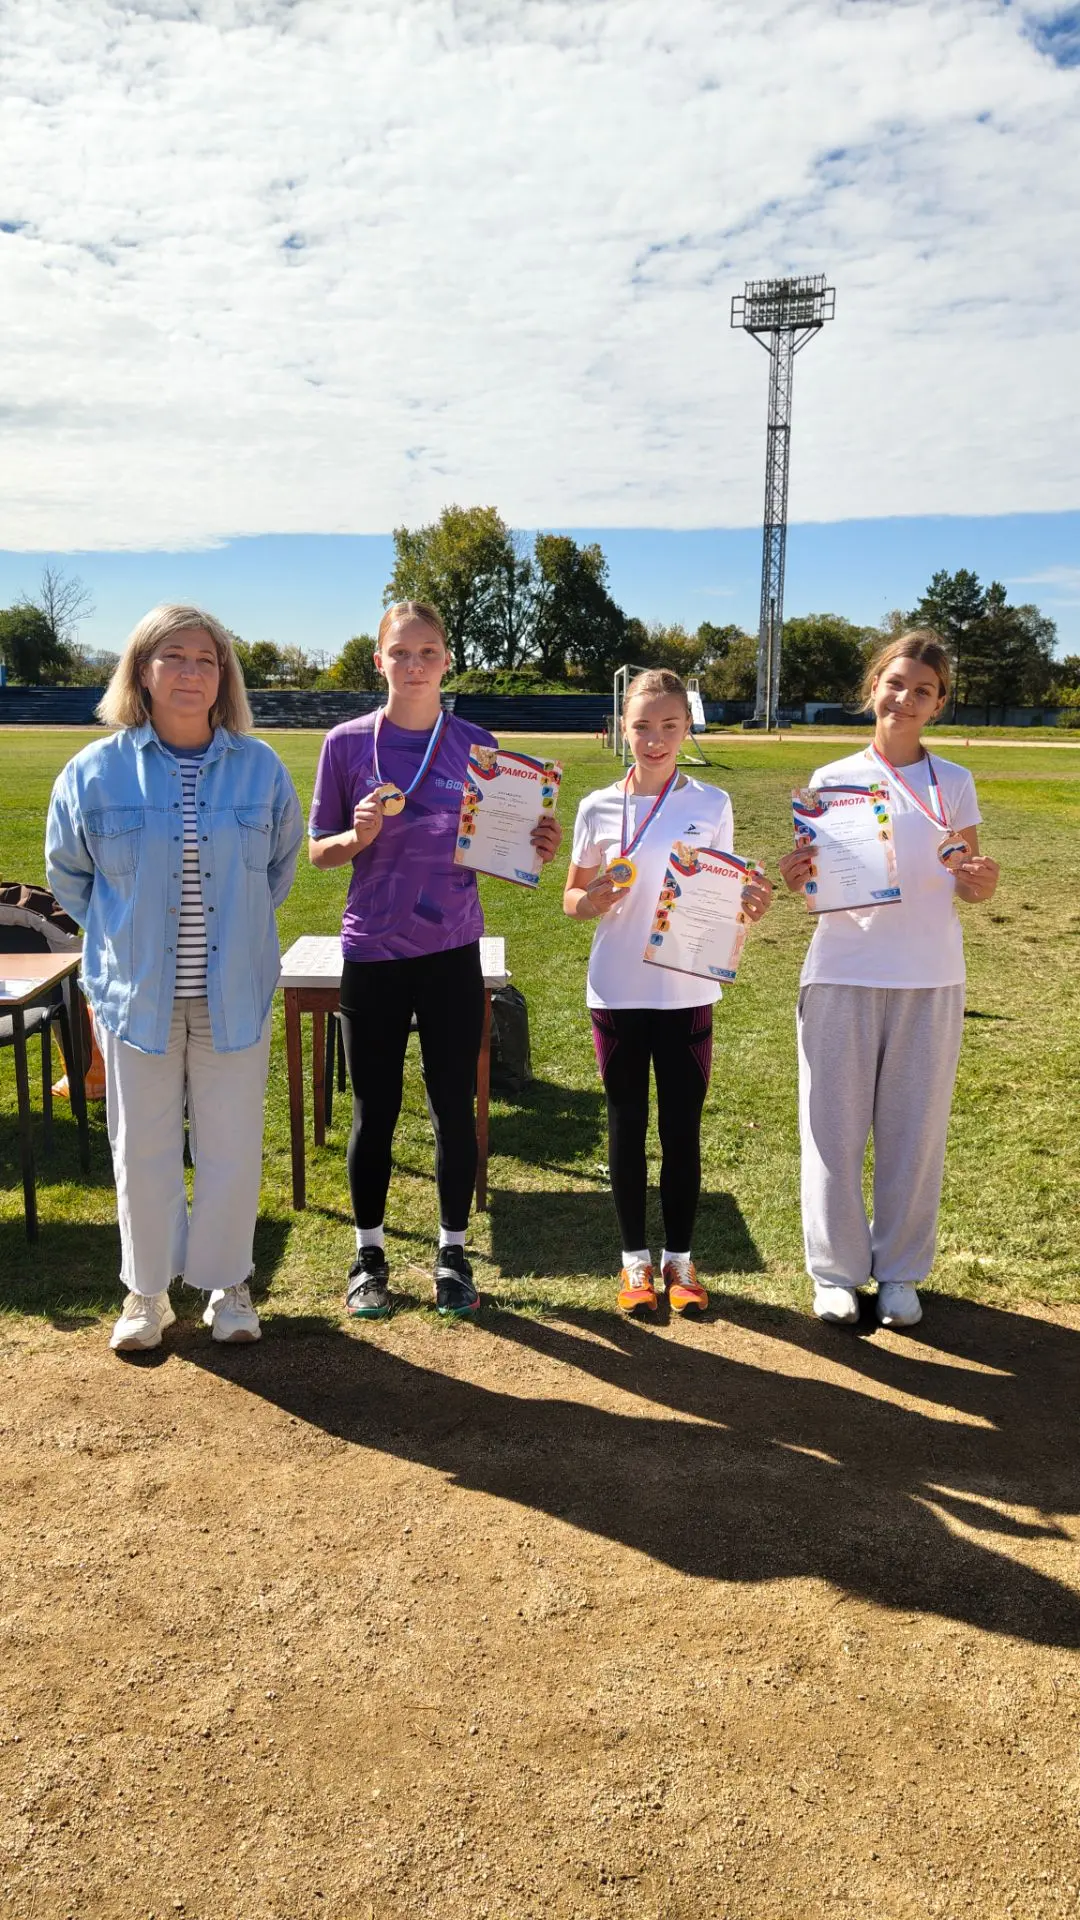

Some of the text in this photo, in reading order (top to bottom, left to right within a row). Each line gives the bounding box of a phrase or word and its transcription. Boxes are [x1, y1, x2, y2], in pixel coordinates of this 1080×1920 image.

[496, 765, 538, 780] ГРАМОТА
[822, 797, 866, 809] ГРАМОТА
[698, 862, 739, 879] ГРАМОТА
